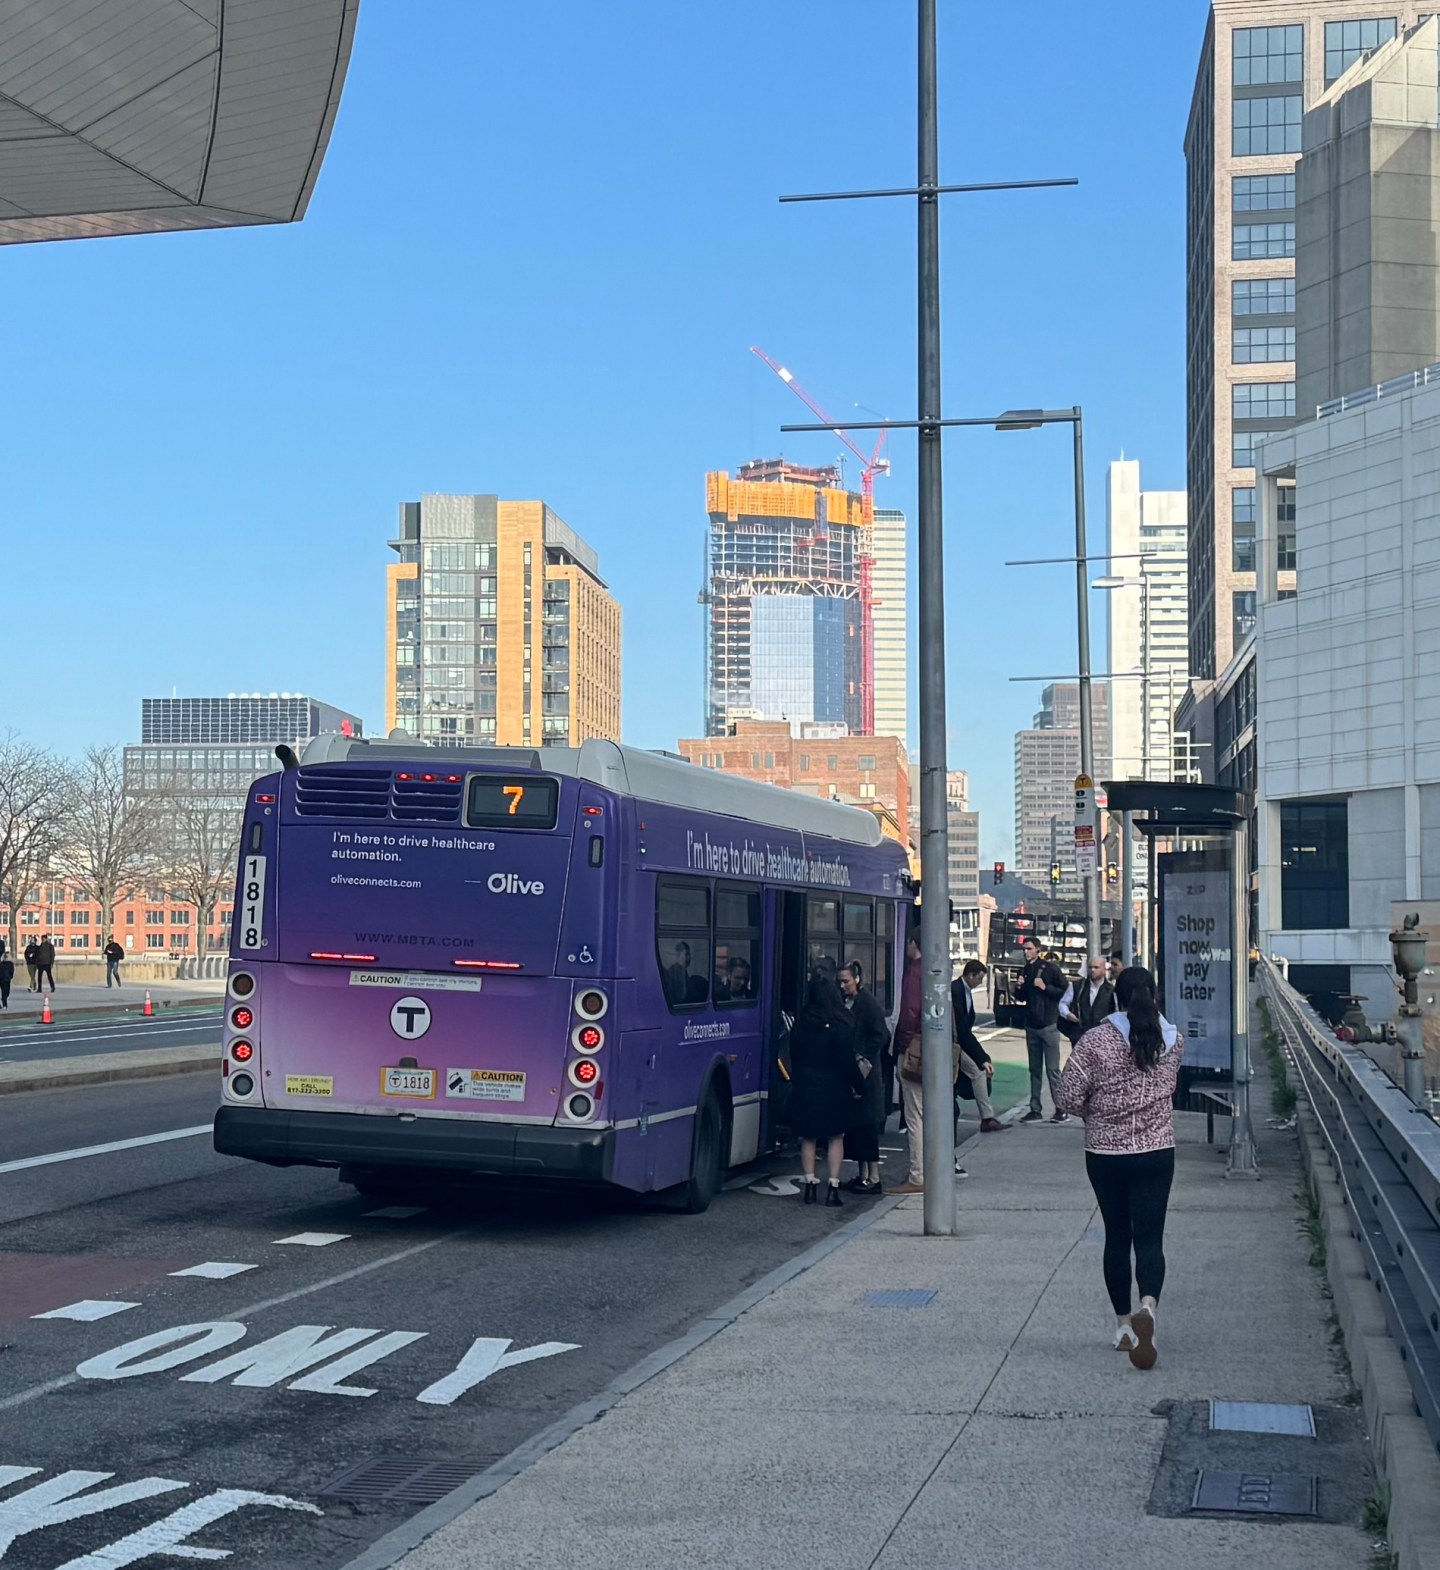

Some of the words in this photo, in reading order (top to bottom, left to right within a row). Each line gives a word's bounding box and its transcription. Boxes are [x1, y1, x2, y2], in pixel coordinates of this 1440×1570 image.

[502, 785, 524, 815] 7
[333, 831, 351, 844] I'm
[354, 833, 381, 845] here
[383, 834, 396, 846] to
[398, 834, 429, 848] drive
[431, 836, 495, 851] healthcare
[331, 849, 402, 862] automation.
[686, 829, 704, 869] I'm
[705, 831, 729, 873] here
[730, 839, 740, 875] to
[742, 838, 765, 878] drive
[766, 842, 809, 882] healthcare
[810, 854, 851, 887] automation.
[330, 874, 422, 889] oliveconnects.com
[487, 873, 545, 895] Olive
[245, 858, 260, 947] 1818
[1176, 913, 1216, 936] Shop
[355, 931, 475, 948] WWW.MBTA.COM
[1178, 938, 1210, 955] now
[360, 974, 402, 985] CAUTION
[1183, 962, 1210, 982] pay
[1179, 981, 1216, 1001] later
[396, 1006, 426, 1033] T
[683, 1019, 730, 1040] oliveconnects.com
[403, 1076, 430, 1089] 1818
[481, 1071, 524, 1082] CAUTION
[75, 1320, 582, 1405] ONLY
